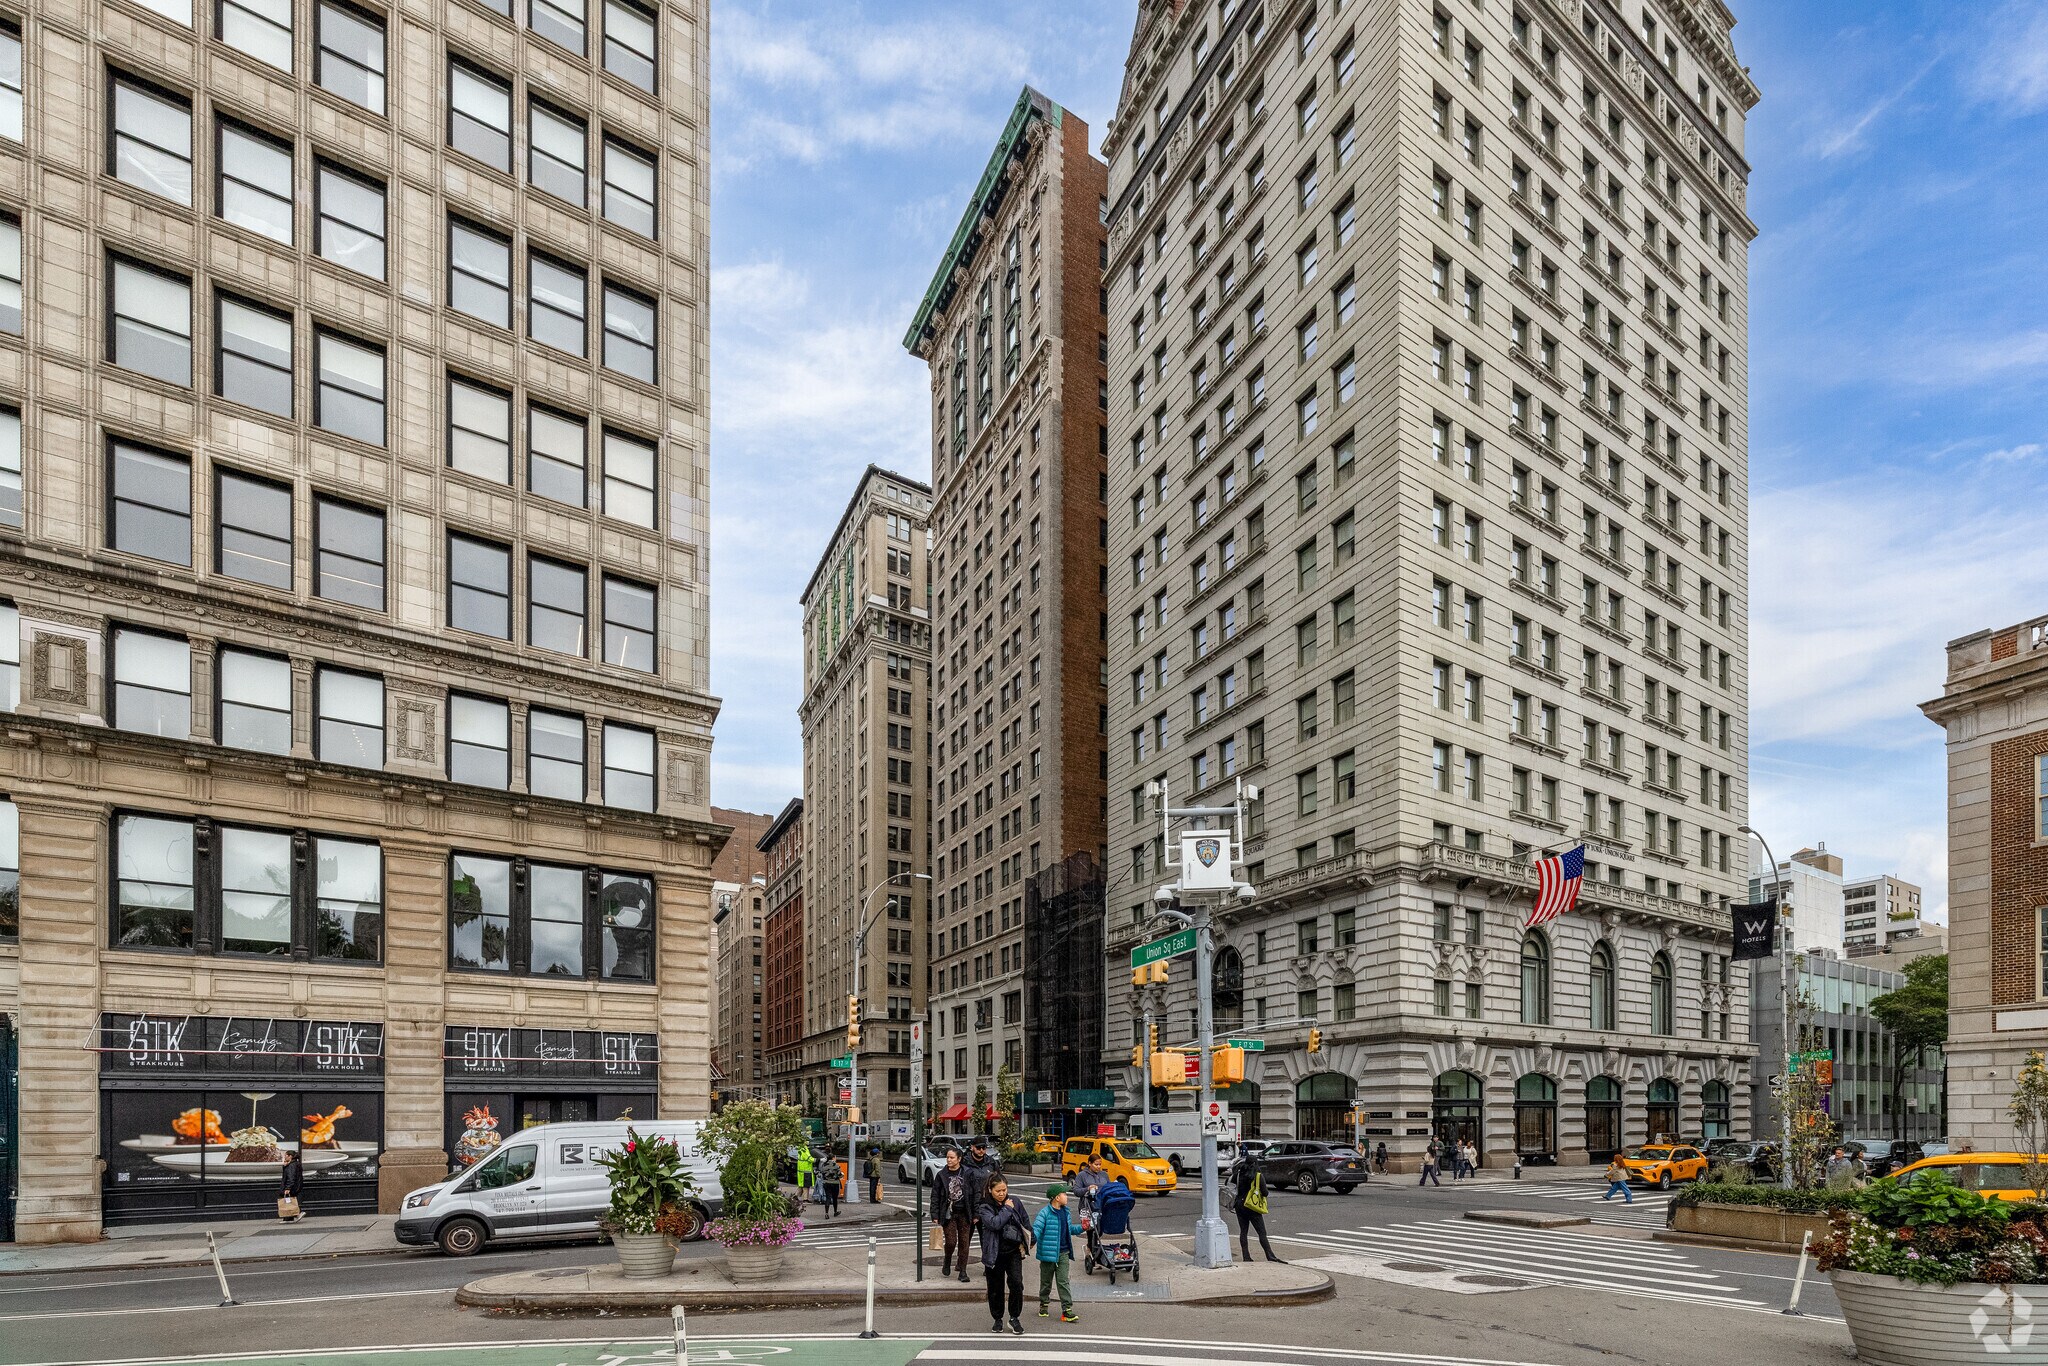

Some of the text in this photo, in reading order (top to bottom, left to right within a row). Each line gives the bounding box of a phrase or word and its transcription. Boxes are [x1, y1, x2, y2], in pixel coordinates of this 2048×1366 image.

[1604, 848, 1620, 857] UNION
[1619, 853, 1635, 862] SQUARE
[1743, 919, 1768, 935] W
[1146, 935, 1187, 960] Union Sq East
[1741, 935, 1766, 944] HOTELS
[129, 1020, 184, 1062] STK
[222, 1032, 282, 1051] Coming
[317, 1026, 364, 1065] STK
[464, 1032, 506, 1068] STK
[534, 1042, 579, 1059] Coming
[1249, 1041, 1254, 1049] St
[605, 1037, 641, 1071] STK
